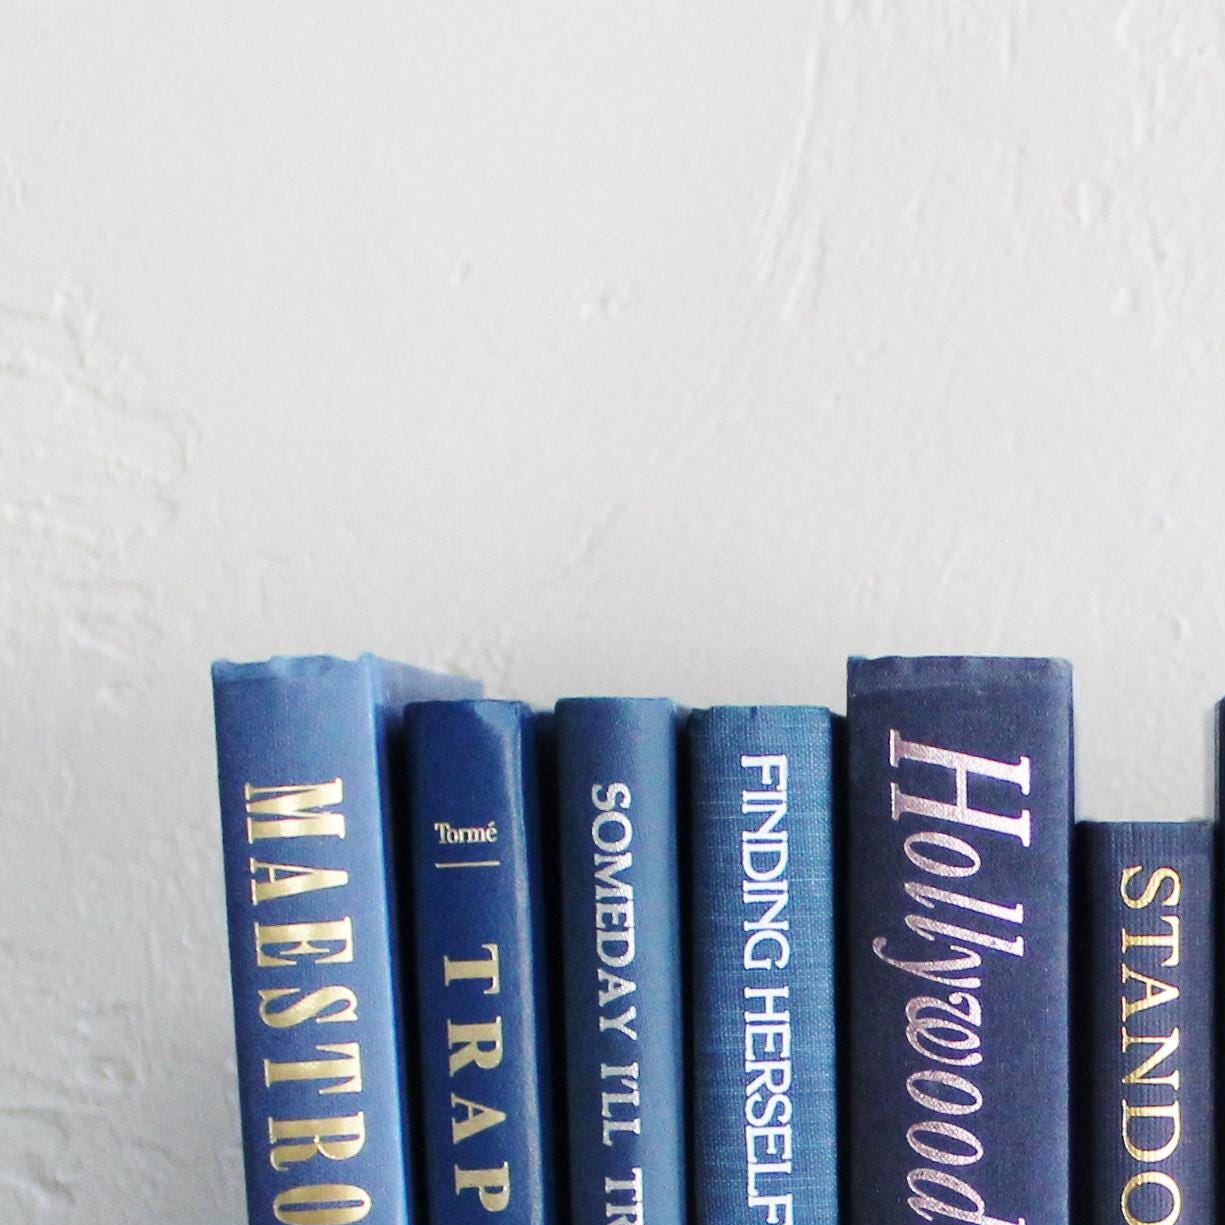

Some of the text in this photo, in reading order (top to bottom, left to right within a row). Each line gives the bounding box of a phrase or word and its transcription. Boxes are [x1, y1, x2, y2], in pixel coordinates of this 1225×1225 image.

[433, 820, 498, 845] Tormé
[740, 753, 792, 971] FINDING
[590, 780, 640, 1042] SOMEDAY
[599, 1060, 642, 1147] I'LL
